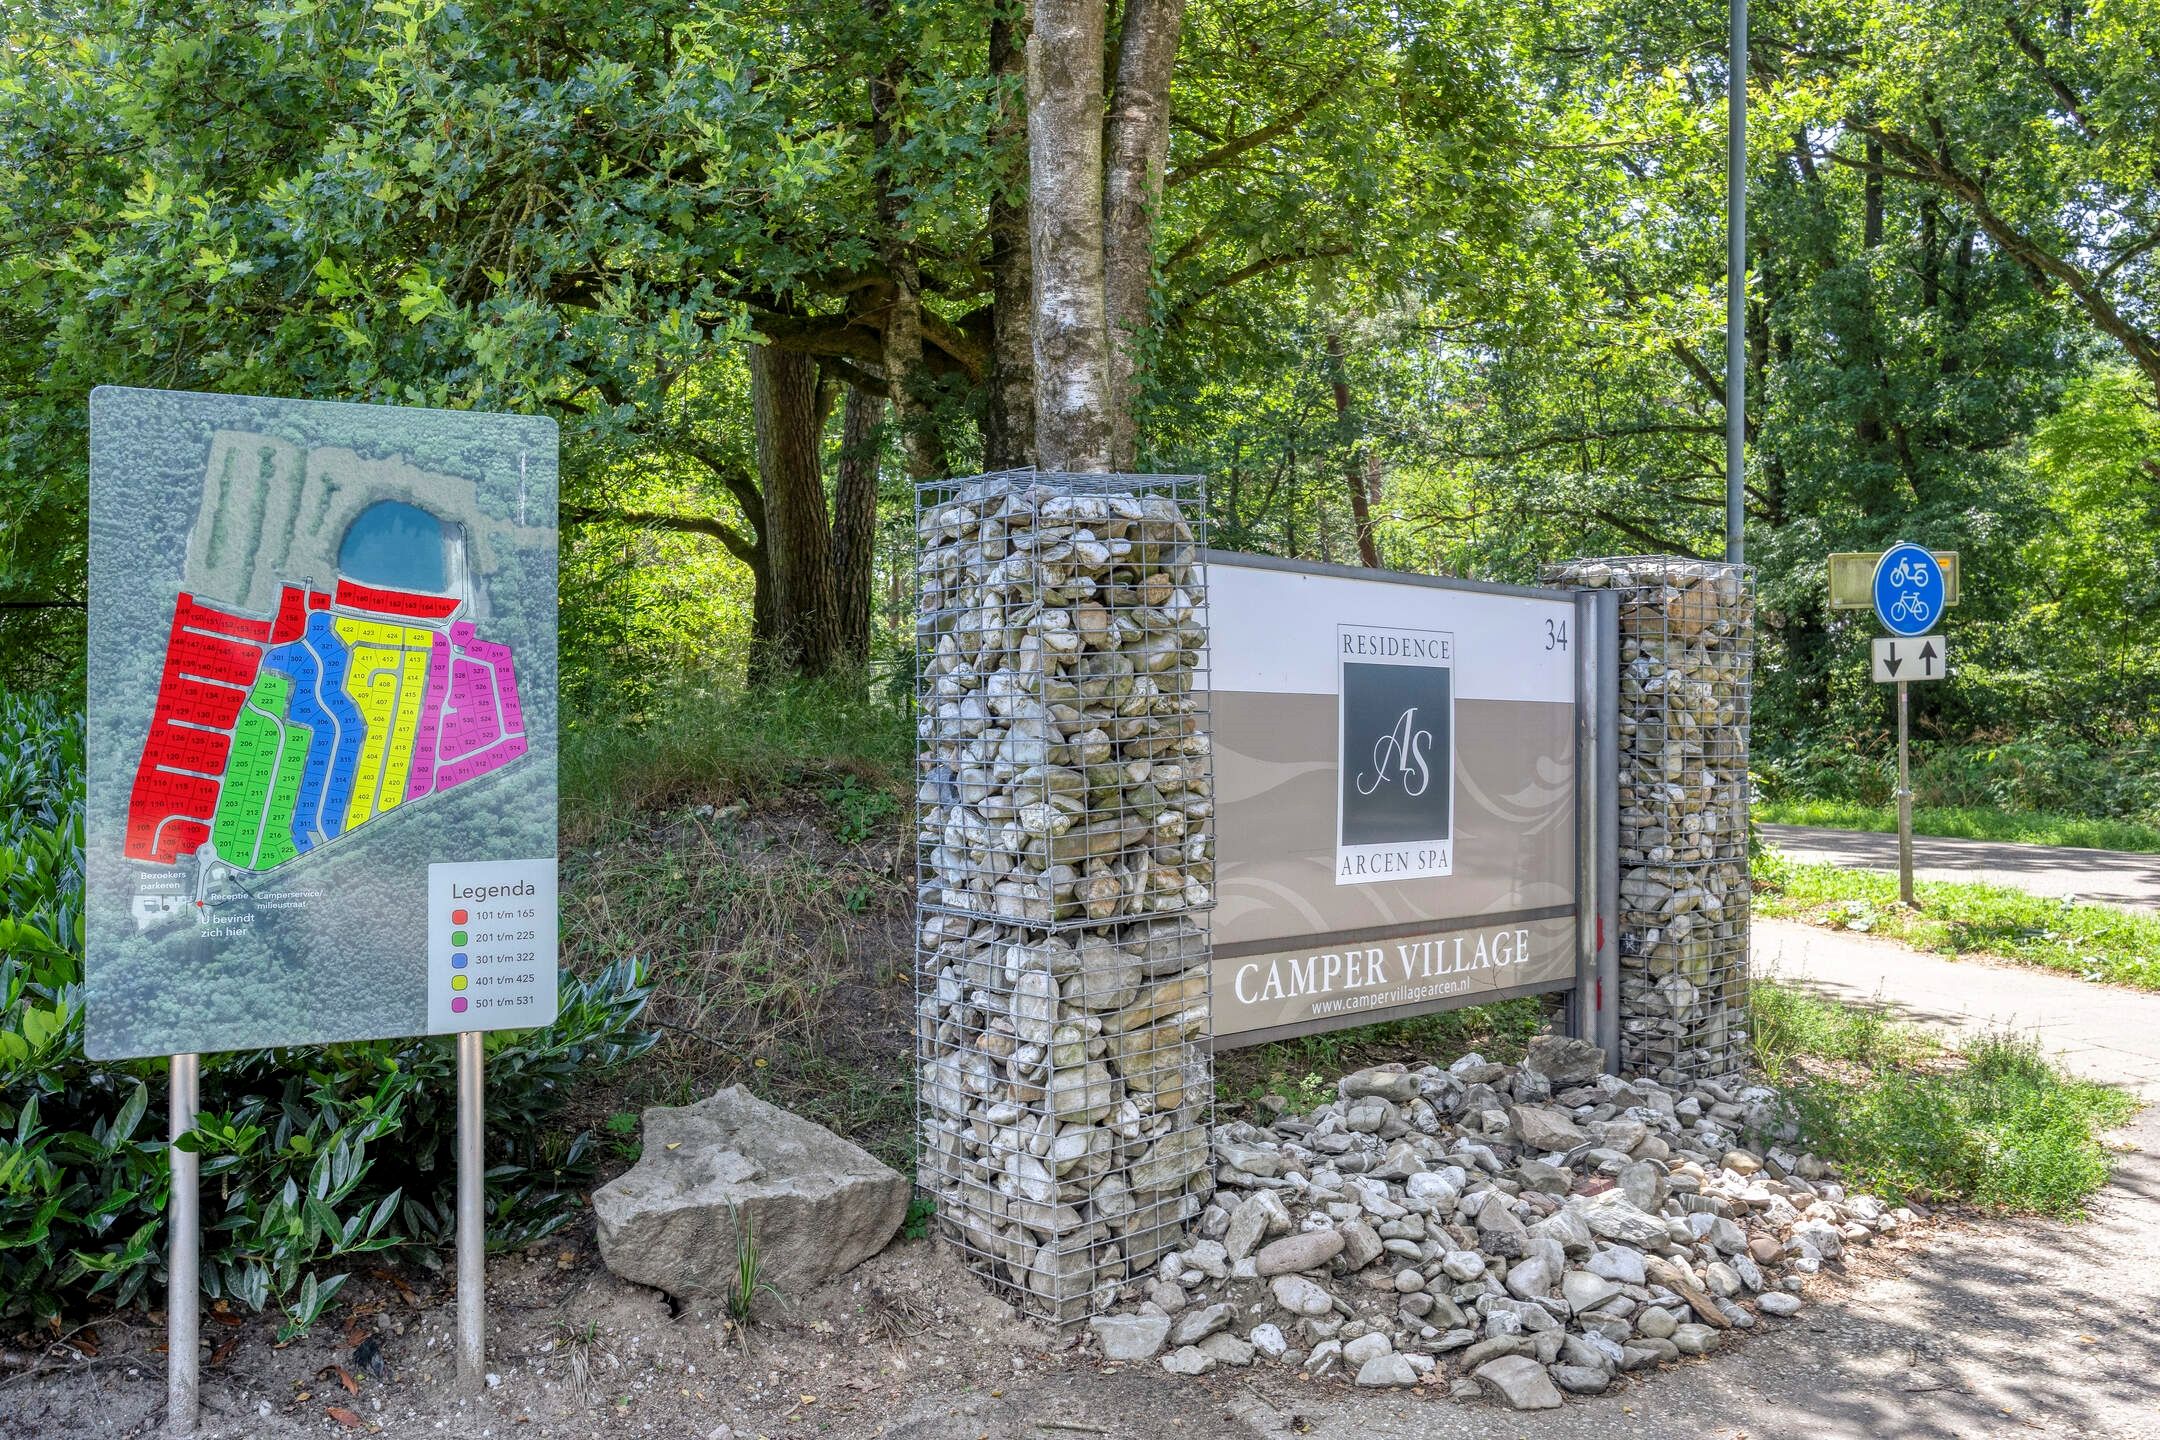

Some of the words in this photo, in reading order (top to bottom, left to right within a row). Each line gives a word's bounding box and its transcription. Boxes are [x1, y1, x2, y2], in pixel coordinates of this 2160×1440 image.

[1545, 619, 1567, 651] 34
[1343, 634, 1450, 659] RESIDENCE
[1341, 852, 1409, 876] ARCEN
[1418, 849, 1448, 870] SPA
[141, 872, 186, 880] Bezoekers
[141, 882, 180, 890] parkeren
[453, 880, 535, 903] Legenda
[211, 893, 249, 901] Receptie
[258, 901, 306, 909] milieustraat
[201, 916, 210, 924] U
[213, 914, 255, 923] bevindt
[476, 912, 493, 920] 101
[497, 910, 513, 919] t/m
[517, 909, 534, 918] 165
[201, 929, 222, 938] zich
[226, 928, 247, 936] hier
[476, 933, 493, 942] 201
[497, 932, 513, 941] t/m
[516, 931, 534, 940] 225
[476, 955, 493, 964] 301
[497, 954, 513, 963] t/m
[516, 953, 534, 961] 322
[1234, 948, 1388, 1004] CAMPER
[1397, 929, 1529, 980] VILLAGE
[476, 977, 493, 985] 401
[497, 975, 513, 984] t/m
[516, 974, 534, 983] 425
[1311, 976, 1470, 1015] www.campervillagearcen.nl
[476, 999, 493, 1008] 501
[497, 997, 513, 1006] t/m
[516, 996, 534, 1005] 531
